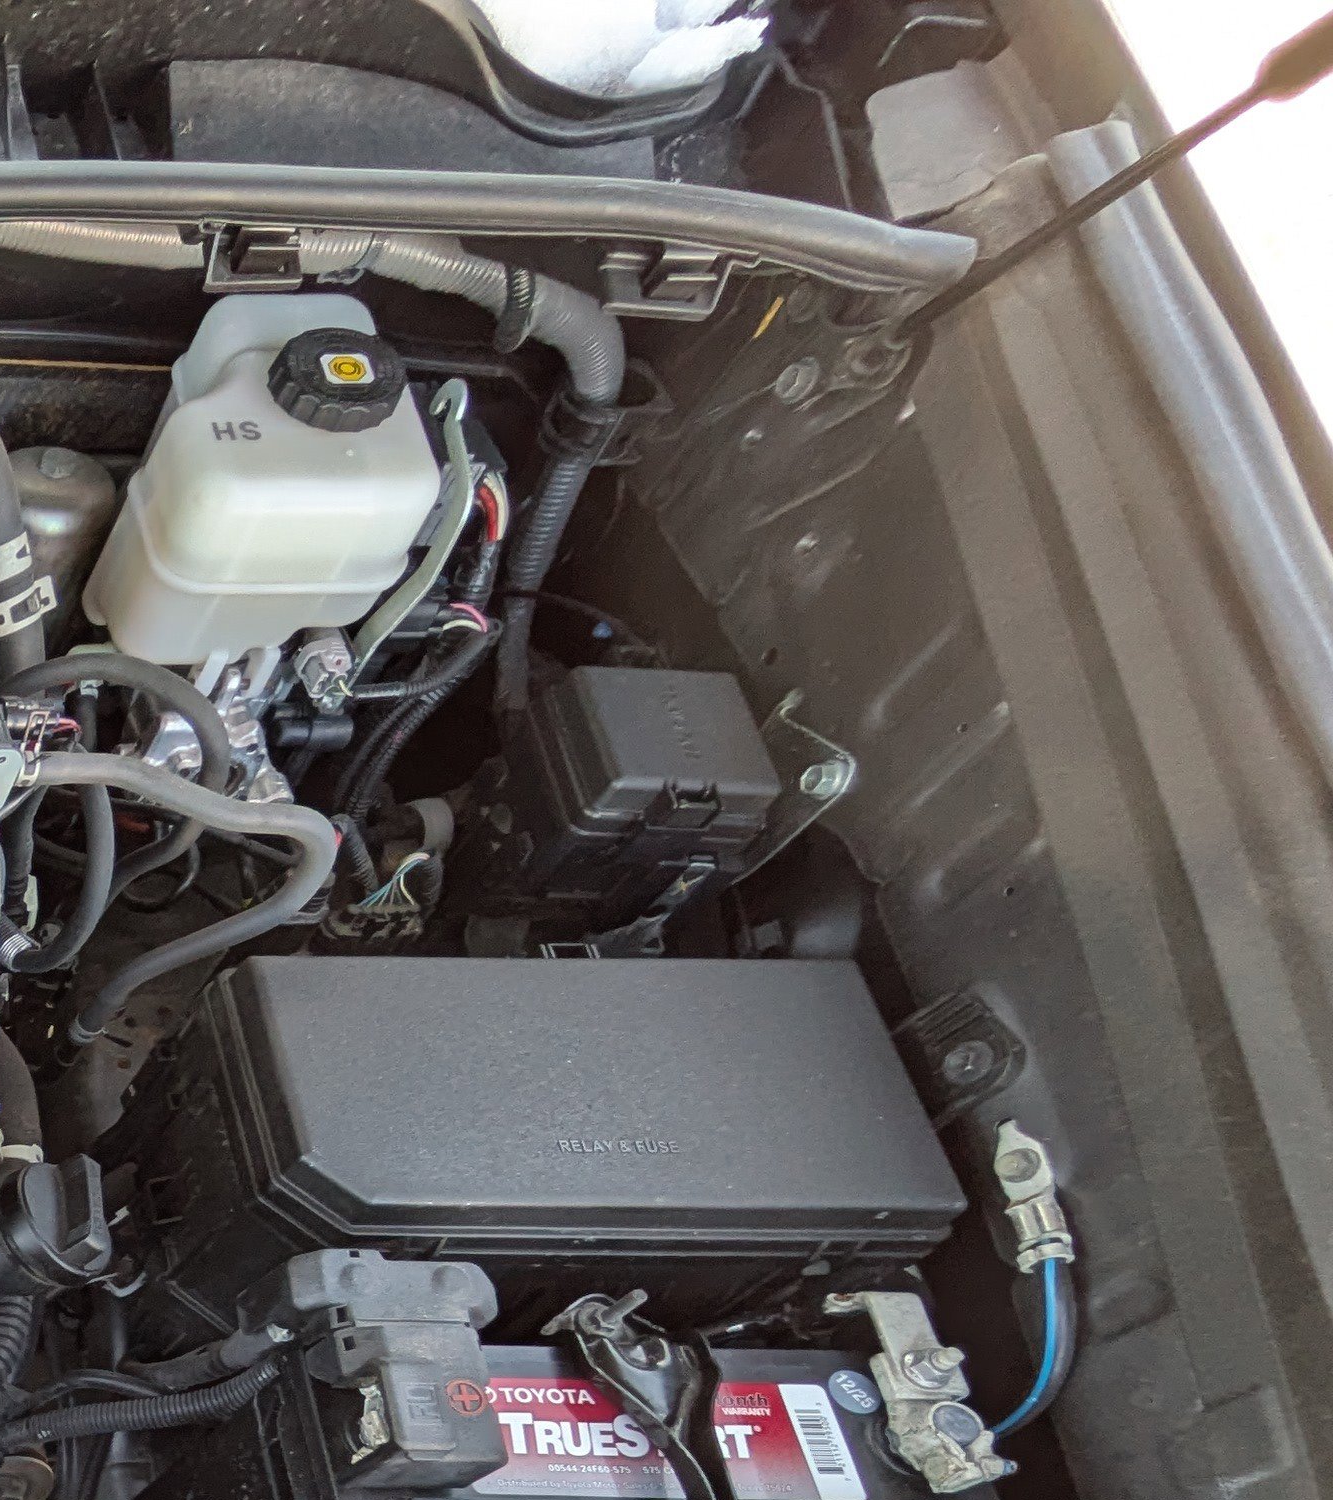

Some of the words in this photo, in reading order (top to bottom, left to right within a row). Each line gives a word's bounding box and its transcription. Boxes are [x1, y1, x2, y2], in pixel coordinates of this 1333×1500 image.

[211, 420, 263, 442] HS
[557, 1138, 613, 1154] RELAY
[619, 1139, 632, 1154] &
[633, 1139, 681, 1155] FUSE
[498, 1386, 596, 1405] TOYOTA
[834, 1372, 874, 1409] 12/25
[721, 1406, 772, 1417] WARRANTY
